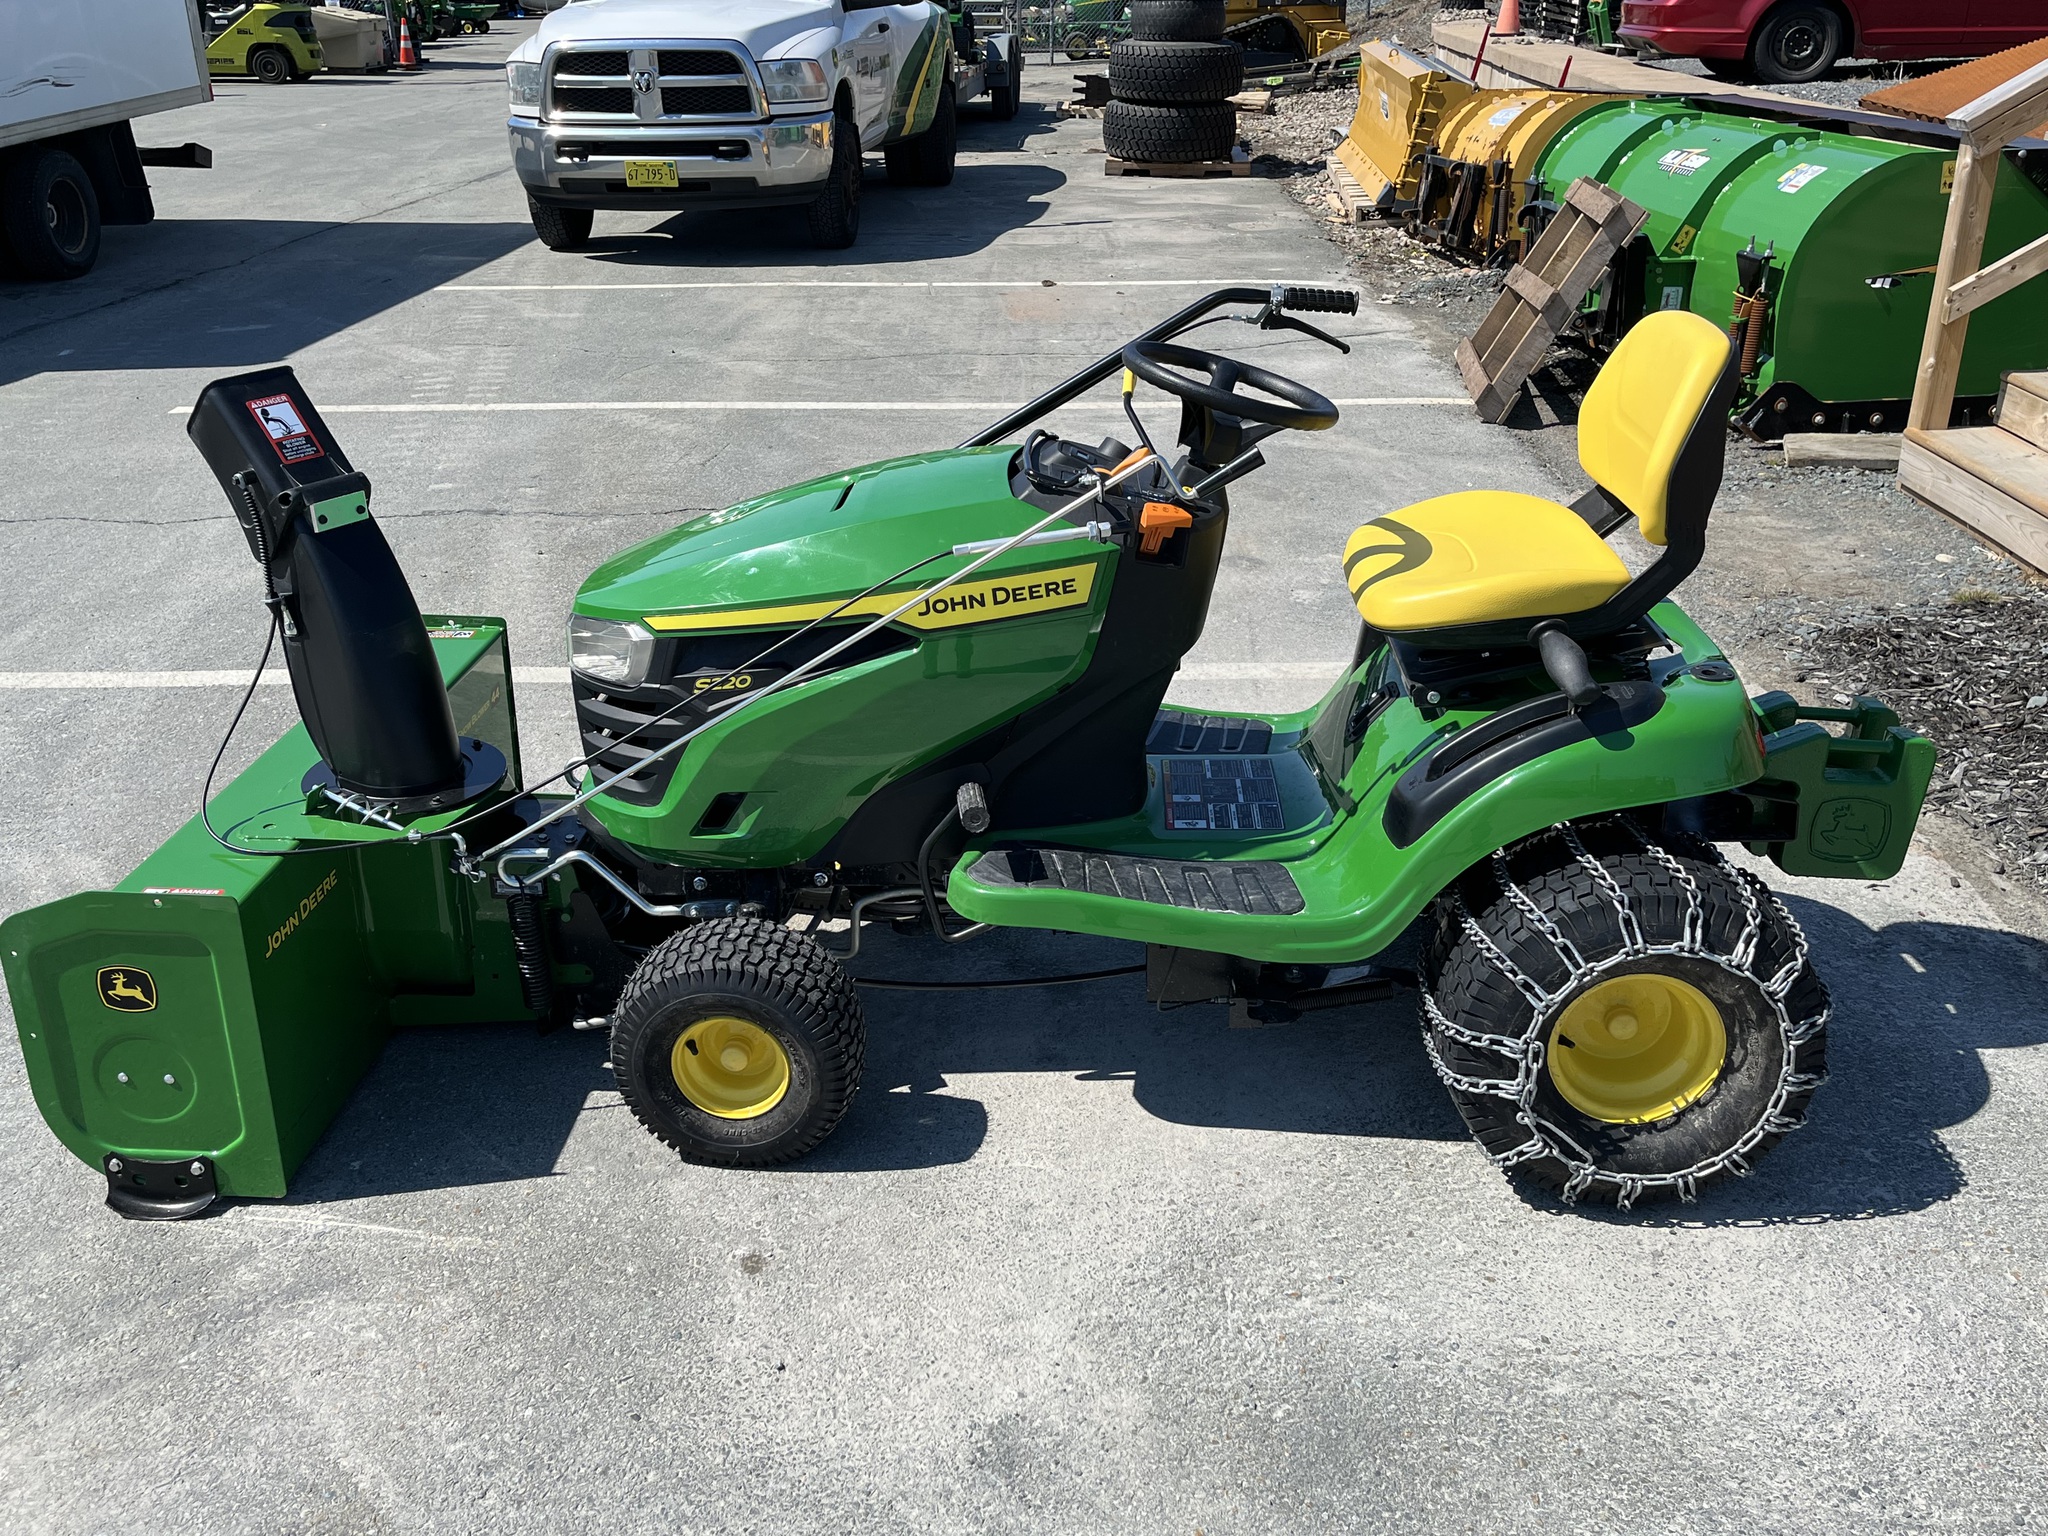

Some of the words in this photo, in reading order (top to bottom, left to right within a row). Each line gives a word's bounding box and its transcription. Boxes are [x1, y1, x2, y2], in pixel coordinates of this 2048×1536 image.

[628, 168, 676, 181] 67-795-D
[257, 395, 288, 407] DANGER
[918, 592, 986, 617] JOHN
[991, 577, 1077, 606] DEERE
[265, 911, 300, 958] JOHN
[300, 869, 338, 921] DEERE
